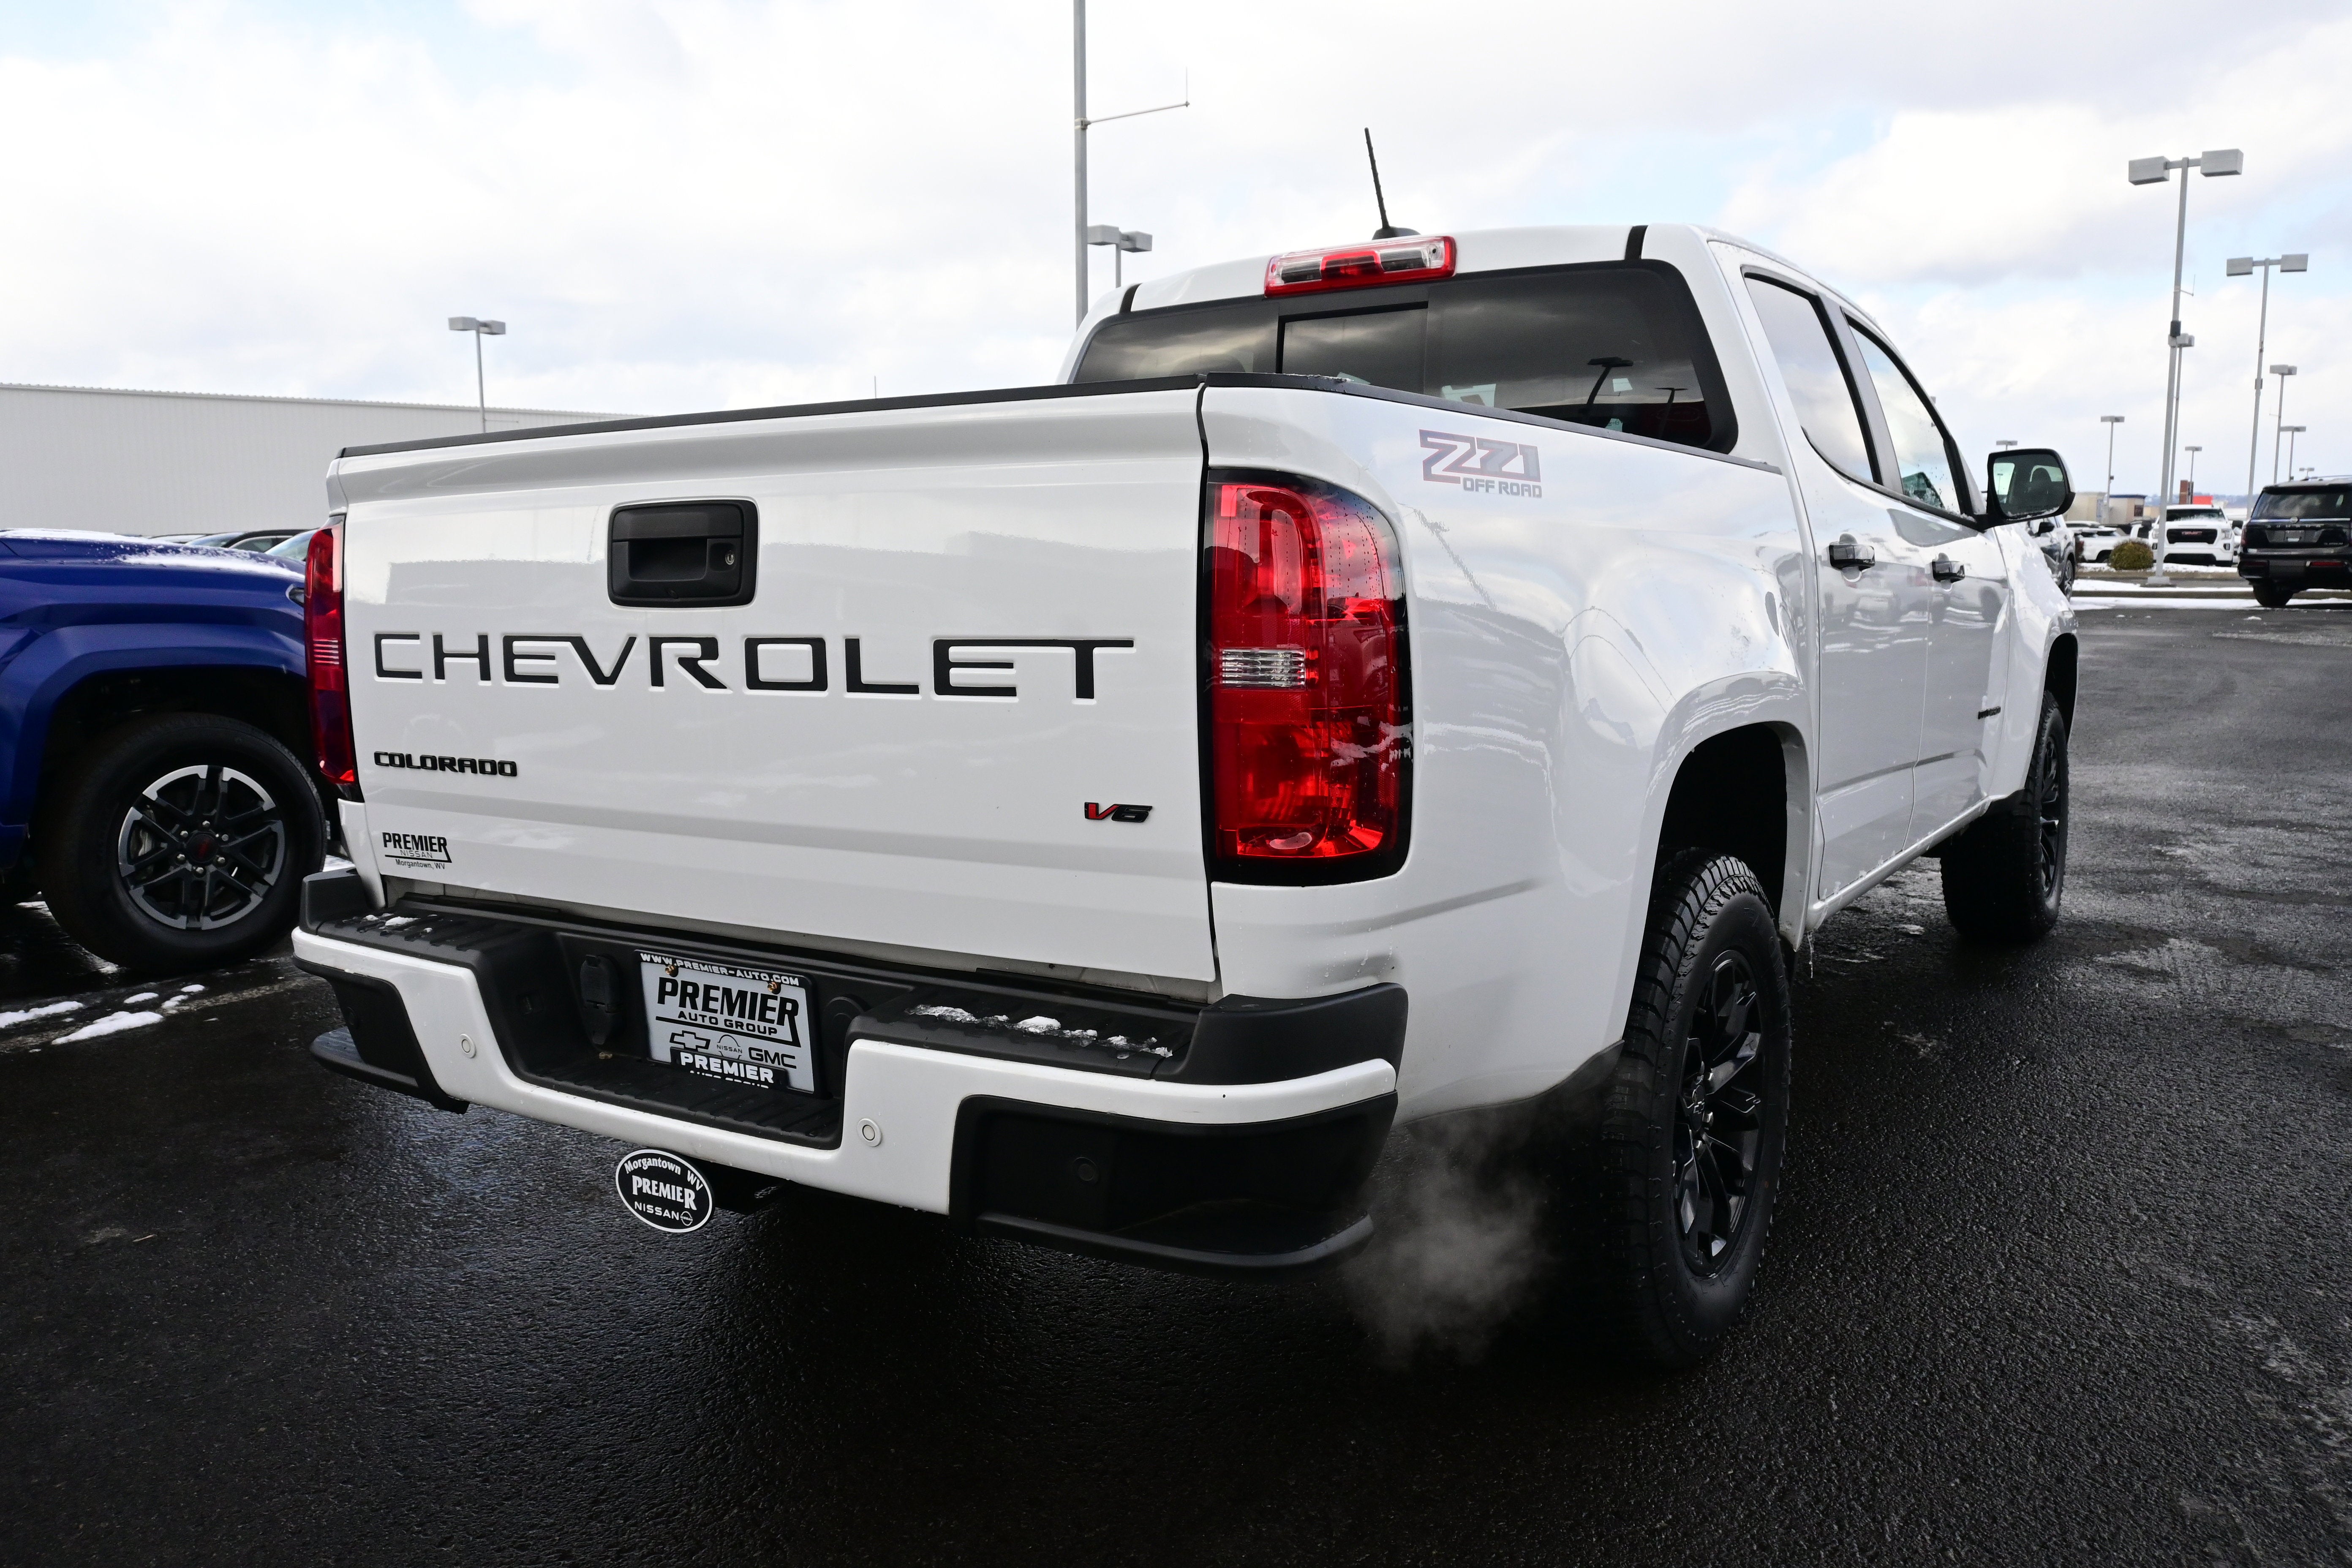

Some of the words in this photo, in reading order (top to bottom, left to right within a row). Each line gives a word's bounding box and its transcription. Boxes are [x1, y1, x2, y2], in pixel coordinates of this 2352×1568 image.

[1419, 429, 1541, 484] Z71
[1462, 476, 1496, 493] OFF
[1498, 480, 1543, 498] ROAD
[374, 633, 1135, 700] CHEVROLET
[374, 751, 518, 777] COLORADO
[1084, 801, 1153, 823] V6
[382, 832, 448, 853] PREMIER
[400, 849, 433, 858] NISSAN
[395, 858, 434, 870] Morgantown,
[640, 953, 799, 986] WWW.PREMIER-AUTO.COM
[657, 977, 800, 1028] PREMIER
[678, 1010, 719, 1026] AUTO
[724, 1018, 778, 1036] GROUP
[716, 1044, 743, 1054] NISSAN
[748, 1046, 797, 1069] GMC
[680, 1052, 774, 1083] PREMIER
[624, 1157, 681, 1176] Morgantown
[686, 1169, 704, 1191] WV
[632, 1175, 697, 1211] PREMIER
[634, 1201, 679, 1221] NISSAN
